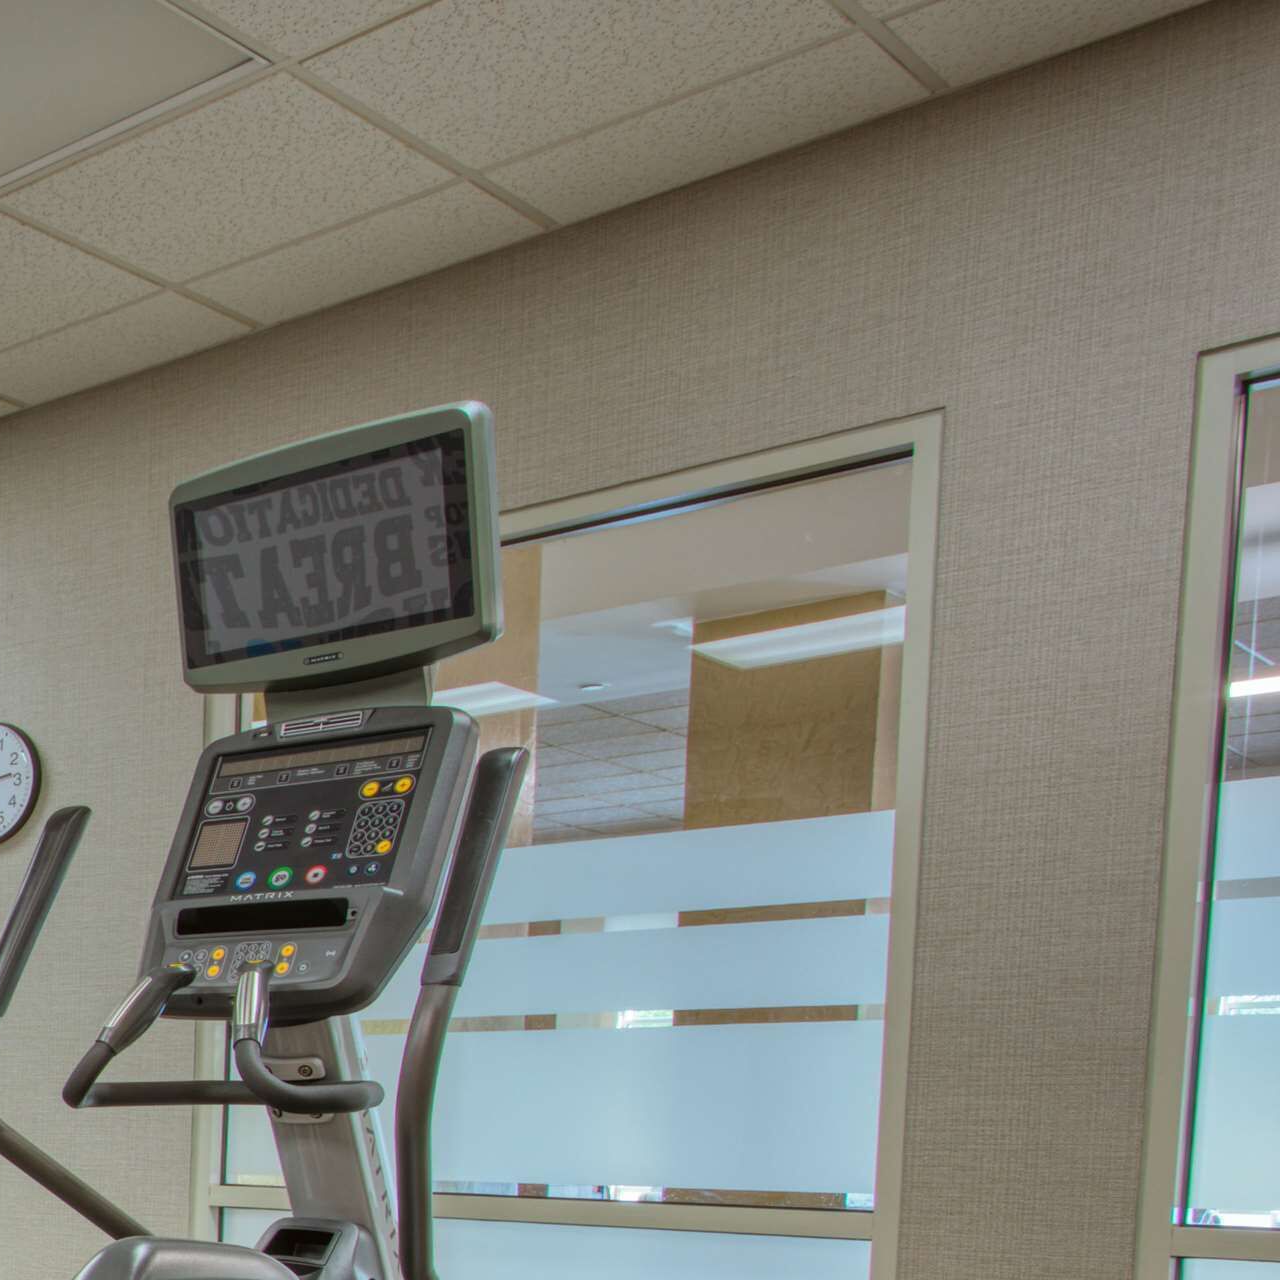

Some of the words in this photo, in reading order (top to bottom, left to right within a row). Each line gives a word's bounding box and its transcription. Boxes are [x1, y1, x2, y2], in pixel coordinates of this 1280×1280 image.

[0, 738, 4, 752] 1
[9, 752, 19, 766] 2
[13, 772, 22, 786] 3
[8, 794, 16, 808] 4
[228, 890, 295, 903] MATRIX
